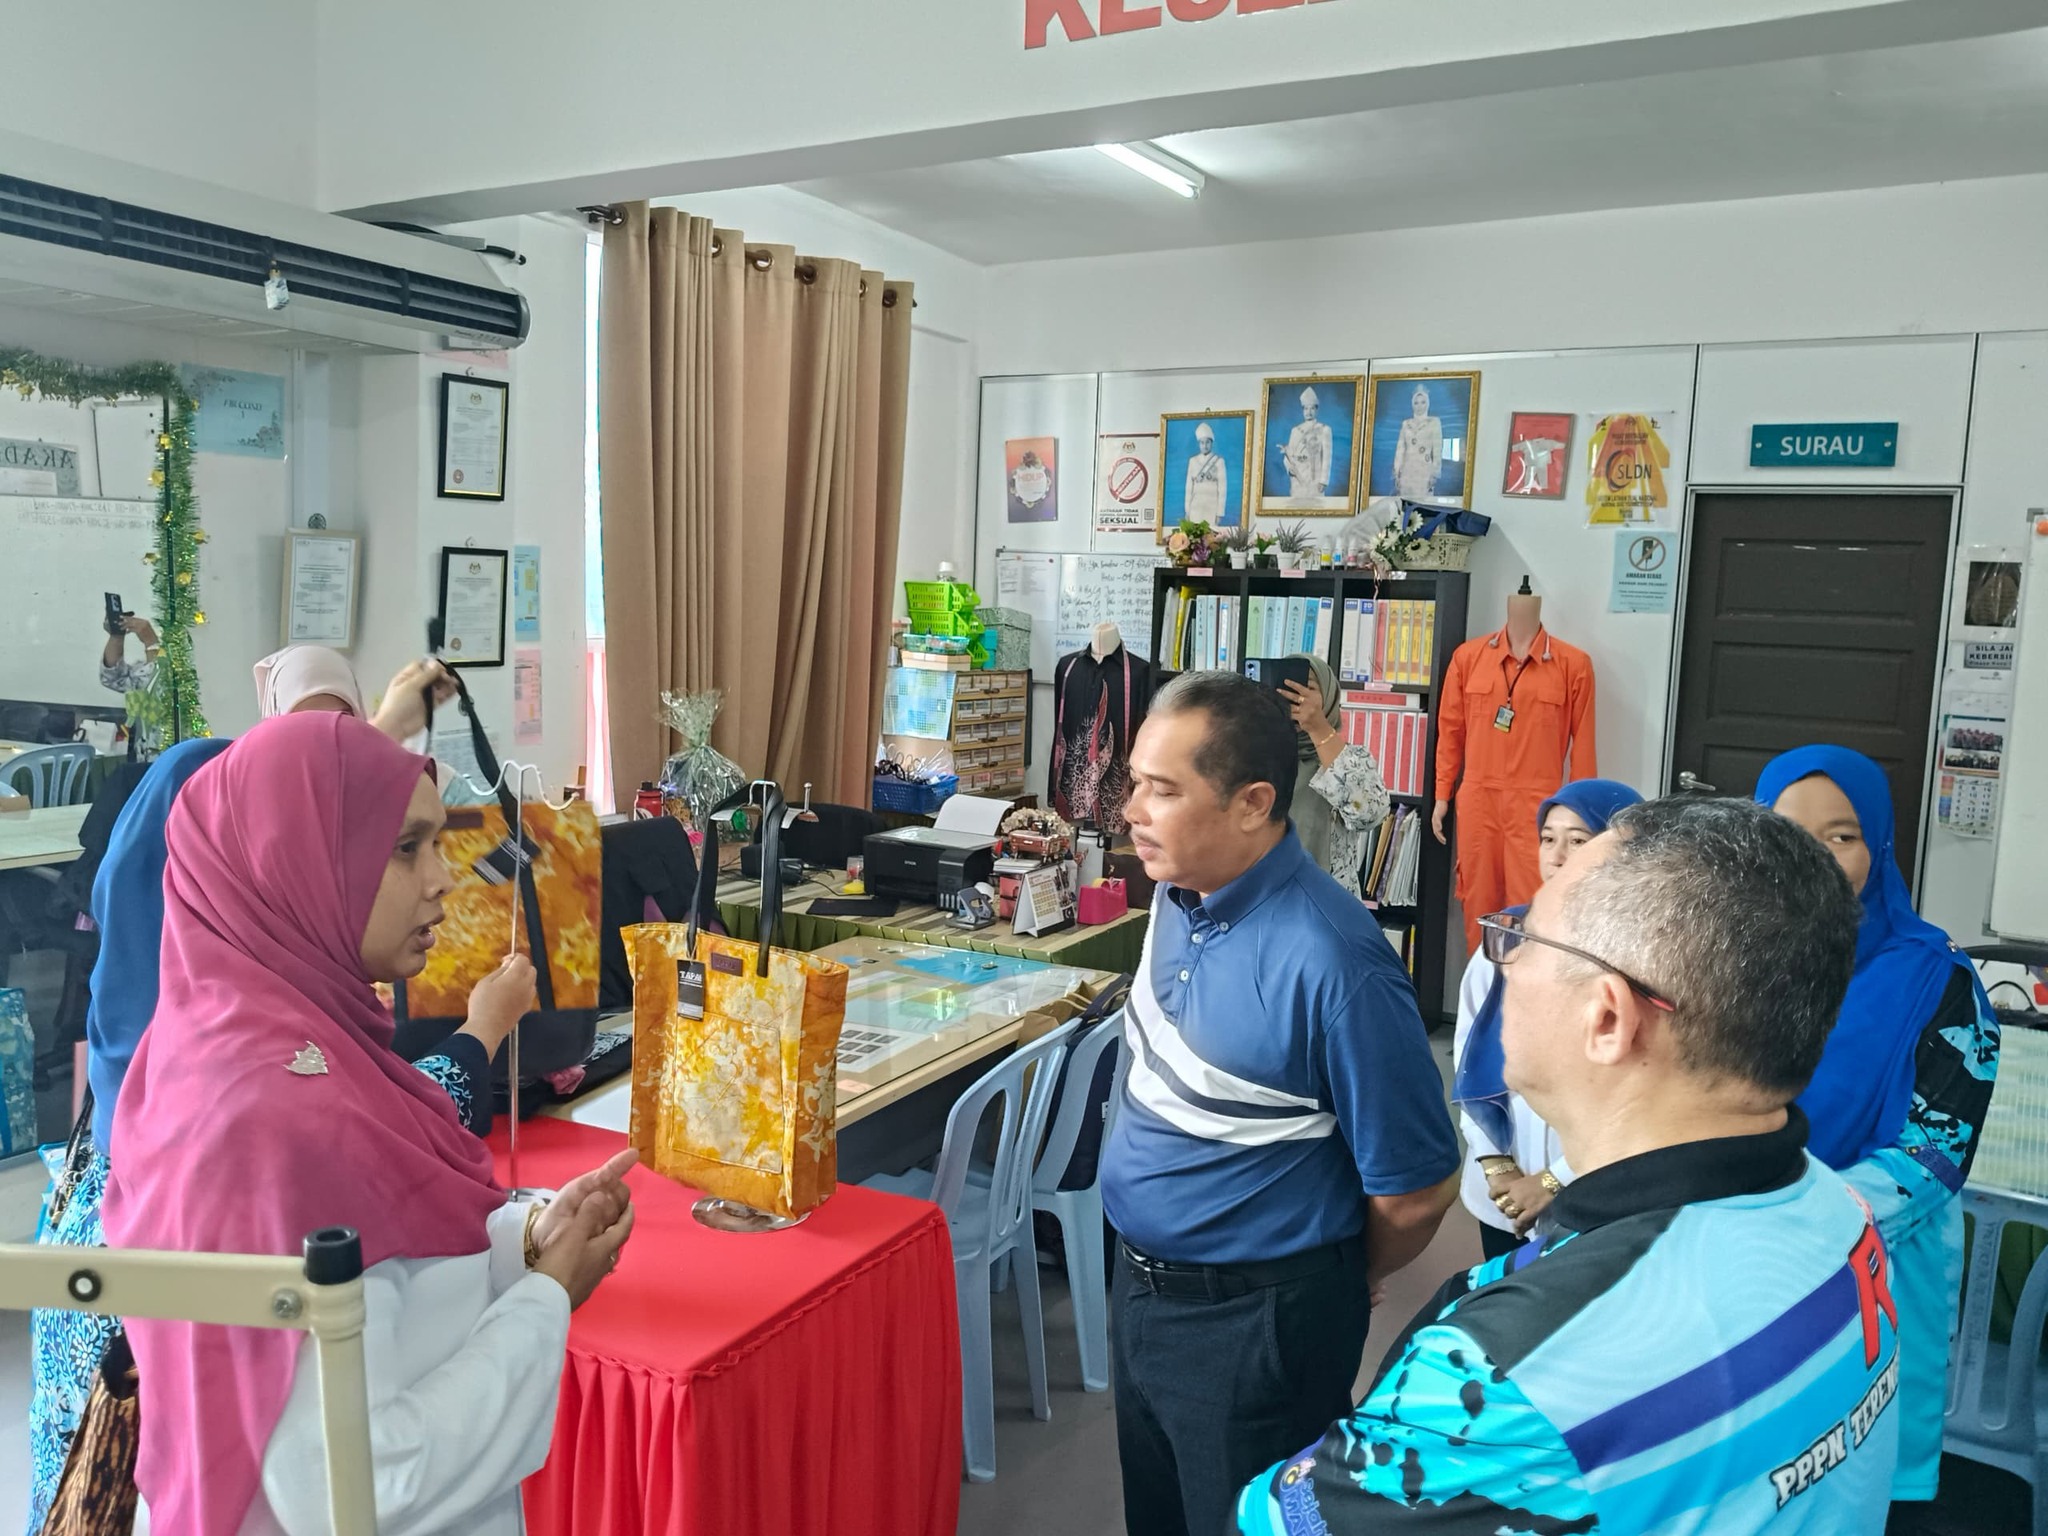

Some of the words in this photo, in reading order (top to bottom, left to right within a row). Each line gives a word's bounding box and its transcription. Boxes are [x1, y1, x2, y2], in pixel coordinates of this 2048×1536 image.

[1780, 435, 1864, 456] SURAU
[1017, 472, 1045, 481] HIDUP
[1617, 463, 1652, 479] SLDN
[1770, 1421, 1847, 1509] PPPN
[1850, 1348, 1899, 1450] TEREN
